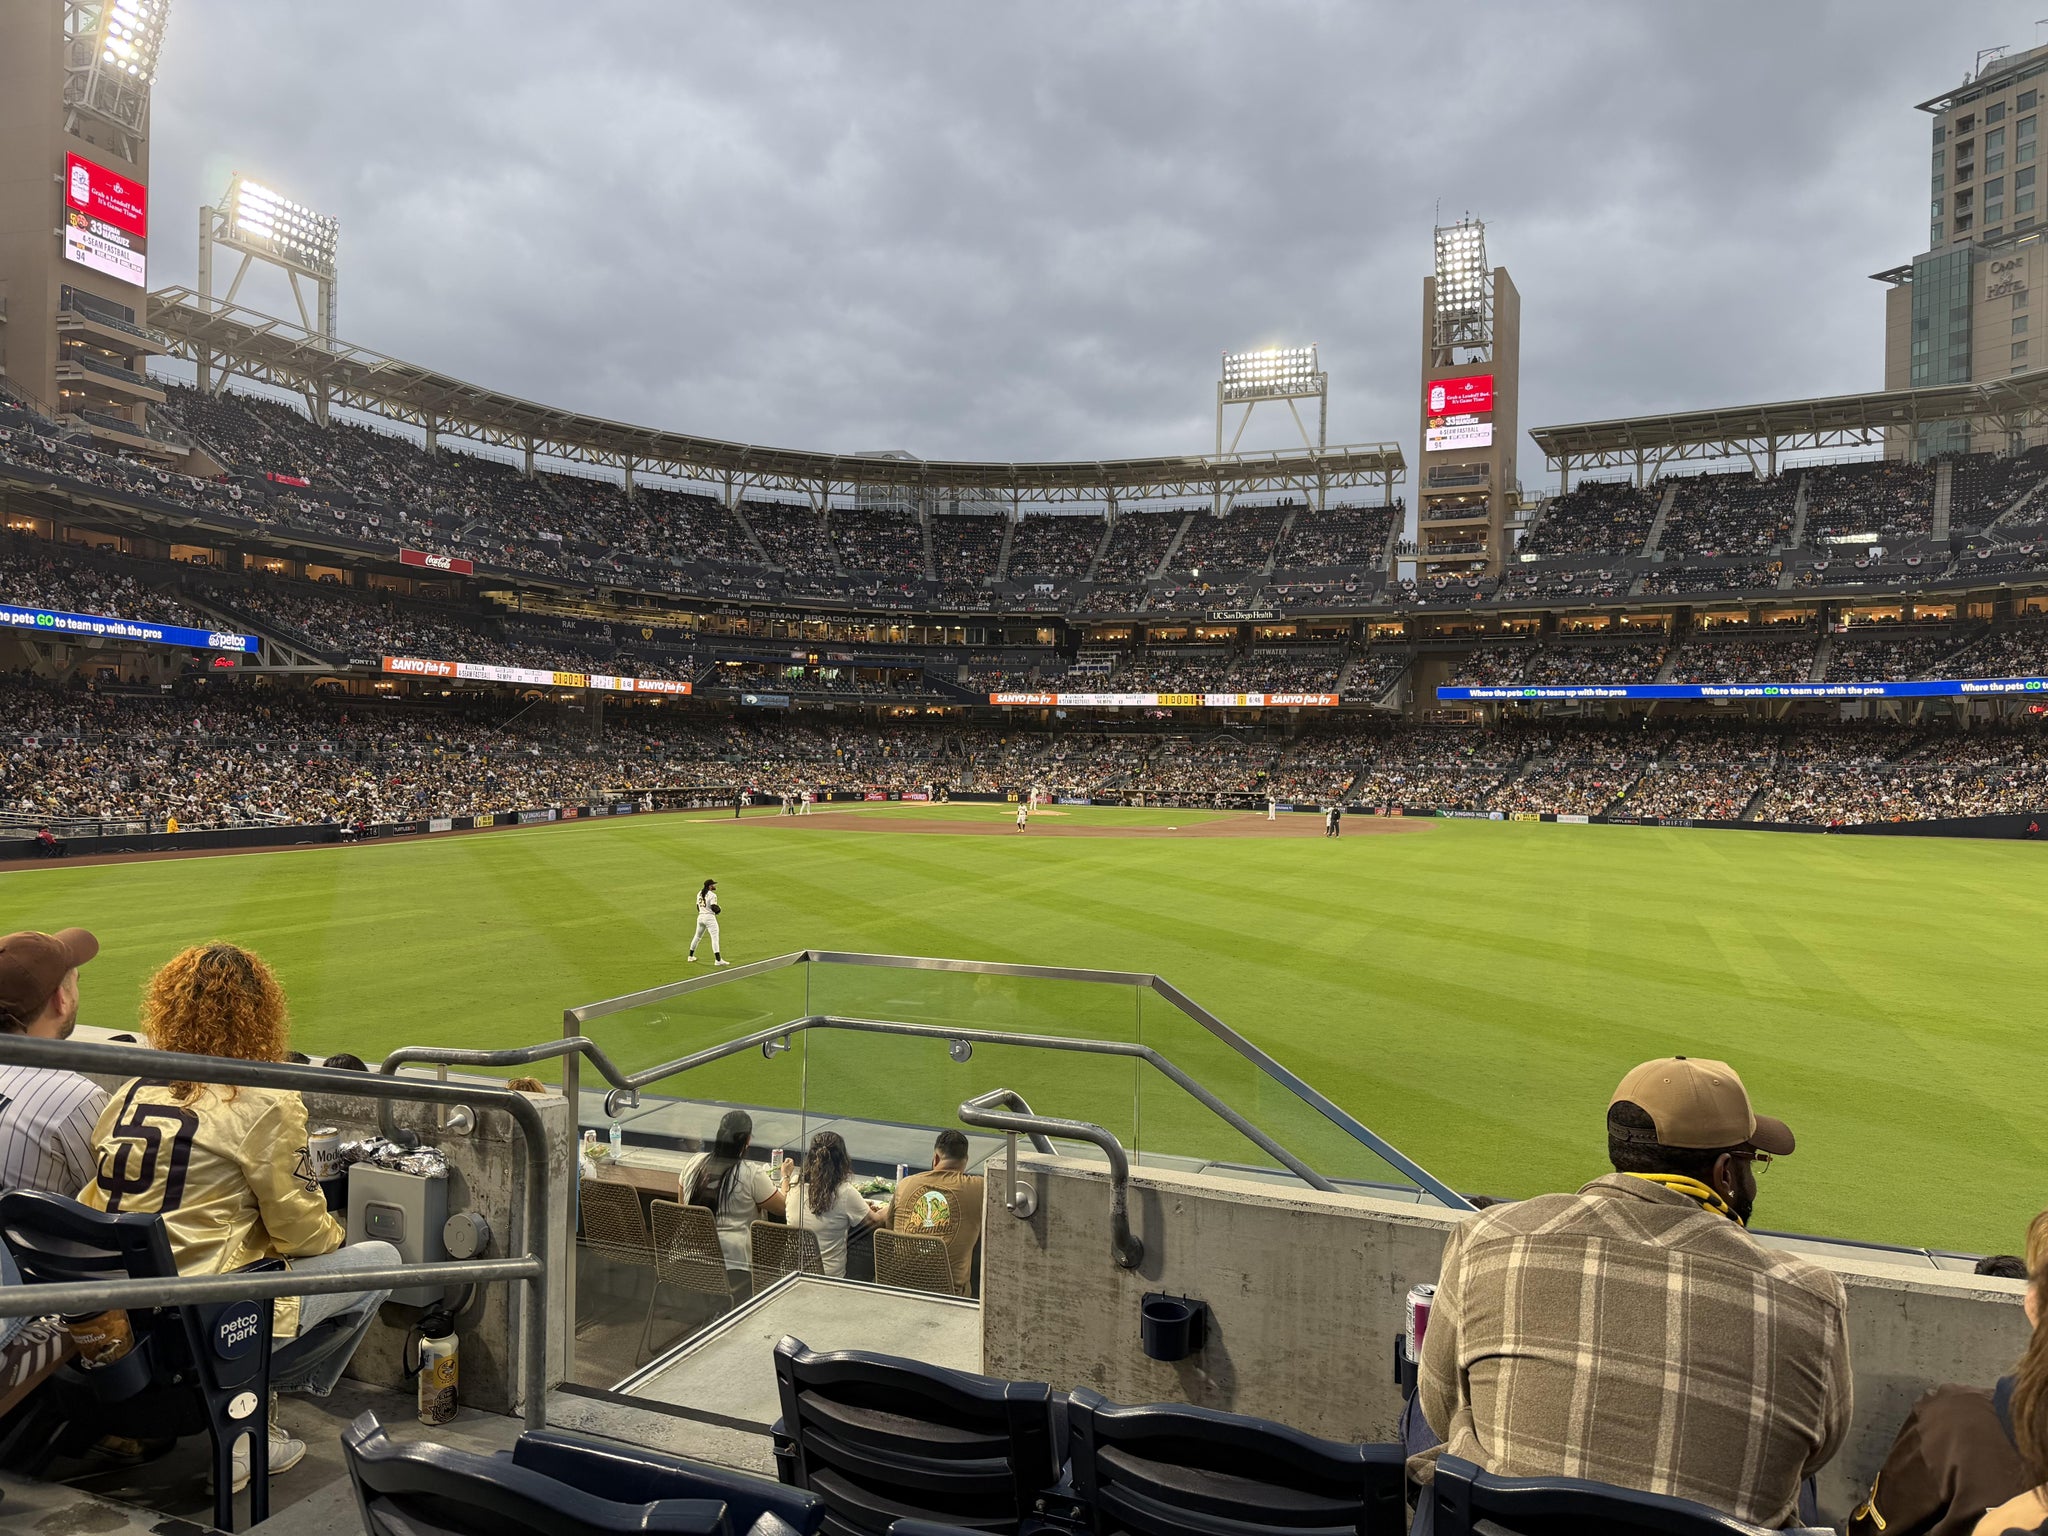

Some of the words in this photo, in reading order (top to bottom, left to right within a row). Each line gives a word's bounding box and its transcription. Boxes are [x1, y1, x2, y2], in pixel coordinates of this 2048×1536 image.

[91, 220, 102, 235] 33
[83, 235, 104, 249] 4-SEAM
[104, 244, 130, 260] FASTBALL
[76, 250, 85, 262] 94
[713, 608, 745, 616] JERRY
[750, 611, 800, 620] COLEMAN
[804, 615, 868, 624] BROADCAST
[1235, 612, 1252, 620] Diego
[1253, 611, 1273, 619] Health
[12, 613, 34, 624] pets
[37, 614, 54, 626] GO
[55, 617, 65, 628] to
[67, 619, 91, 630] team
[93, 623, 105, 634] up
[107, 623, 126, 635] with
[127, 626, 142, 636] the
[143, 630, 162, 639] pros
[562, 621, 576, 629] RAK
[220, 635, 245, 647] petco
[392, 660, 424, 671] SANYO
[424, 662, 439, 674] fish
[439, 663, 451, 675] fry
[638, 681, 663, 690] SANYO
[664, 683, 675, 692] fish
[676, 683, 685, 693] fry
[1702, 687, 1728, 695] Where
[1730, 687, 1743, 695] the
[1744, 688, 1763, 696] pets
[1764, 687, 1779, 695] GO
[1814, 688, 1825, 696] up
[1847, 686, 1862, 694] the
[1863, 687, 1884, 695] pros
[1961, 683, 1988, 691] Where
[2005, 682, 2024, 691] pets
[2026, 681, 2040, 689] GO
[1470, 689, 1493, 697] Where
[1524, 689, 1537, 697] GO
[1040, 695, 1051, 704] fry
[1271, 695, 1300, 703] SANYO
[1304, 695, 1318, 705] fish
[1319, 695, 1330, 705] fry
[317, 1149, 340, 1162] Mod
[221, 1314, 258, 1338] petco
[228, 1325, 257, 1347] park
[240, 1400, 246, 1411] 1
